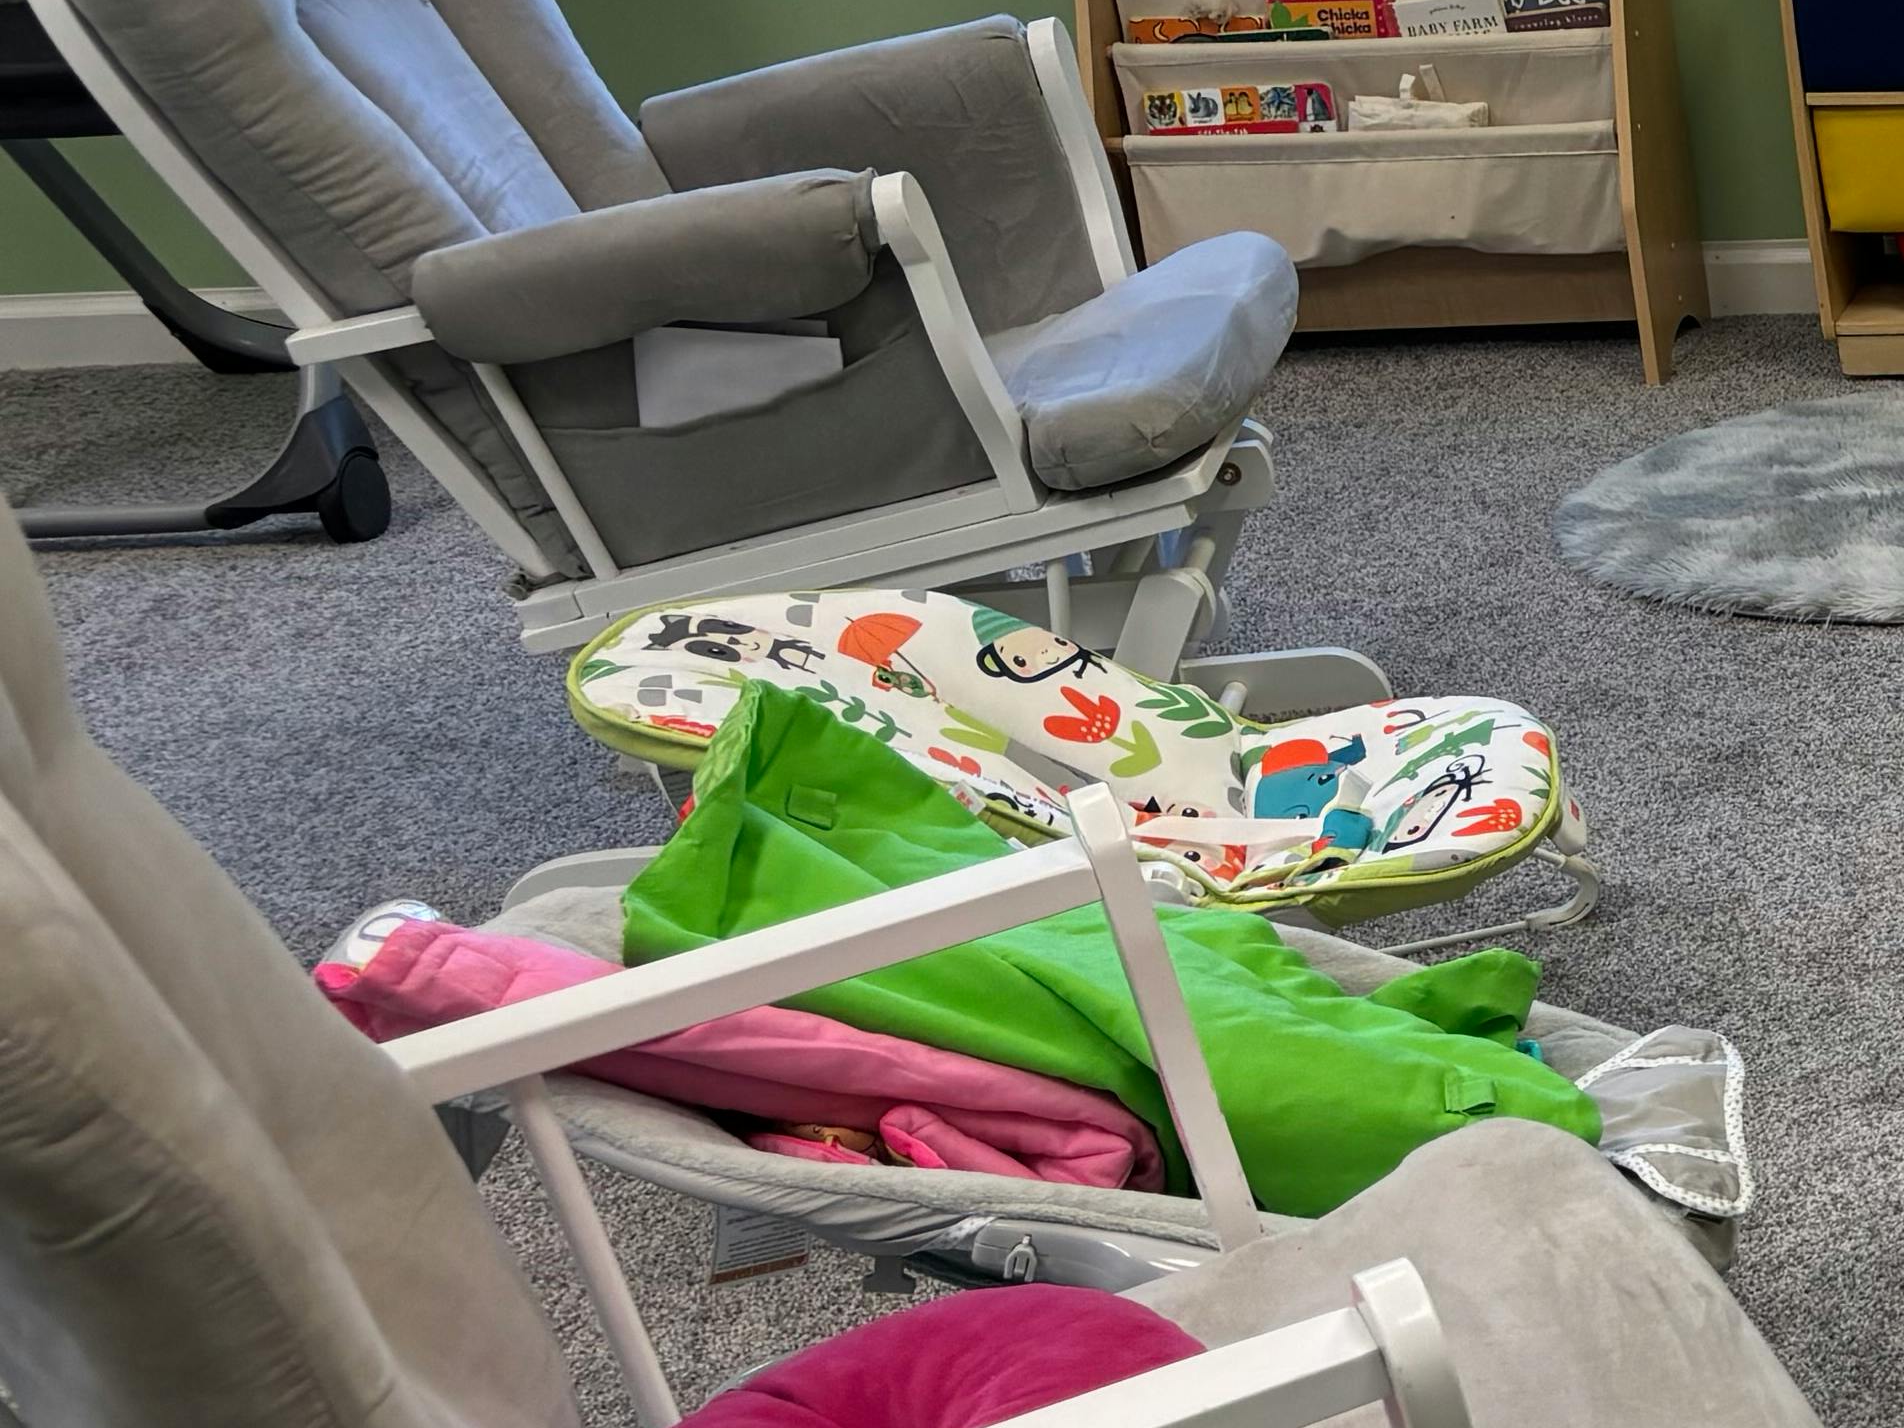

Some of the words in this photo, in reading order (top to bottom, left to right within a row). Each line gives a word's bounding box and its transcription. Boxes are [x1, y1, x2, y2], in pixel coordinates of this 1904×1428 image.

[1317, 8, 1370, 22] Chicka
[1320, 22, 1371, 34] hicka
[1408, 21, 1447, 37] BABY
[1453, 15, 1499, 33] FARM
